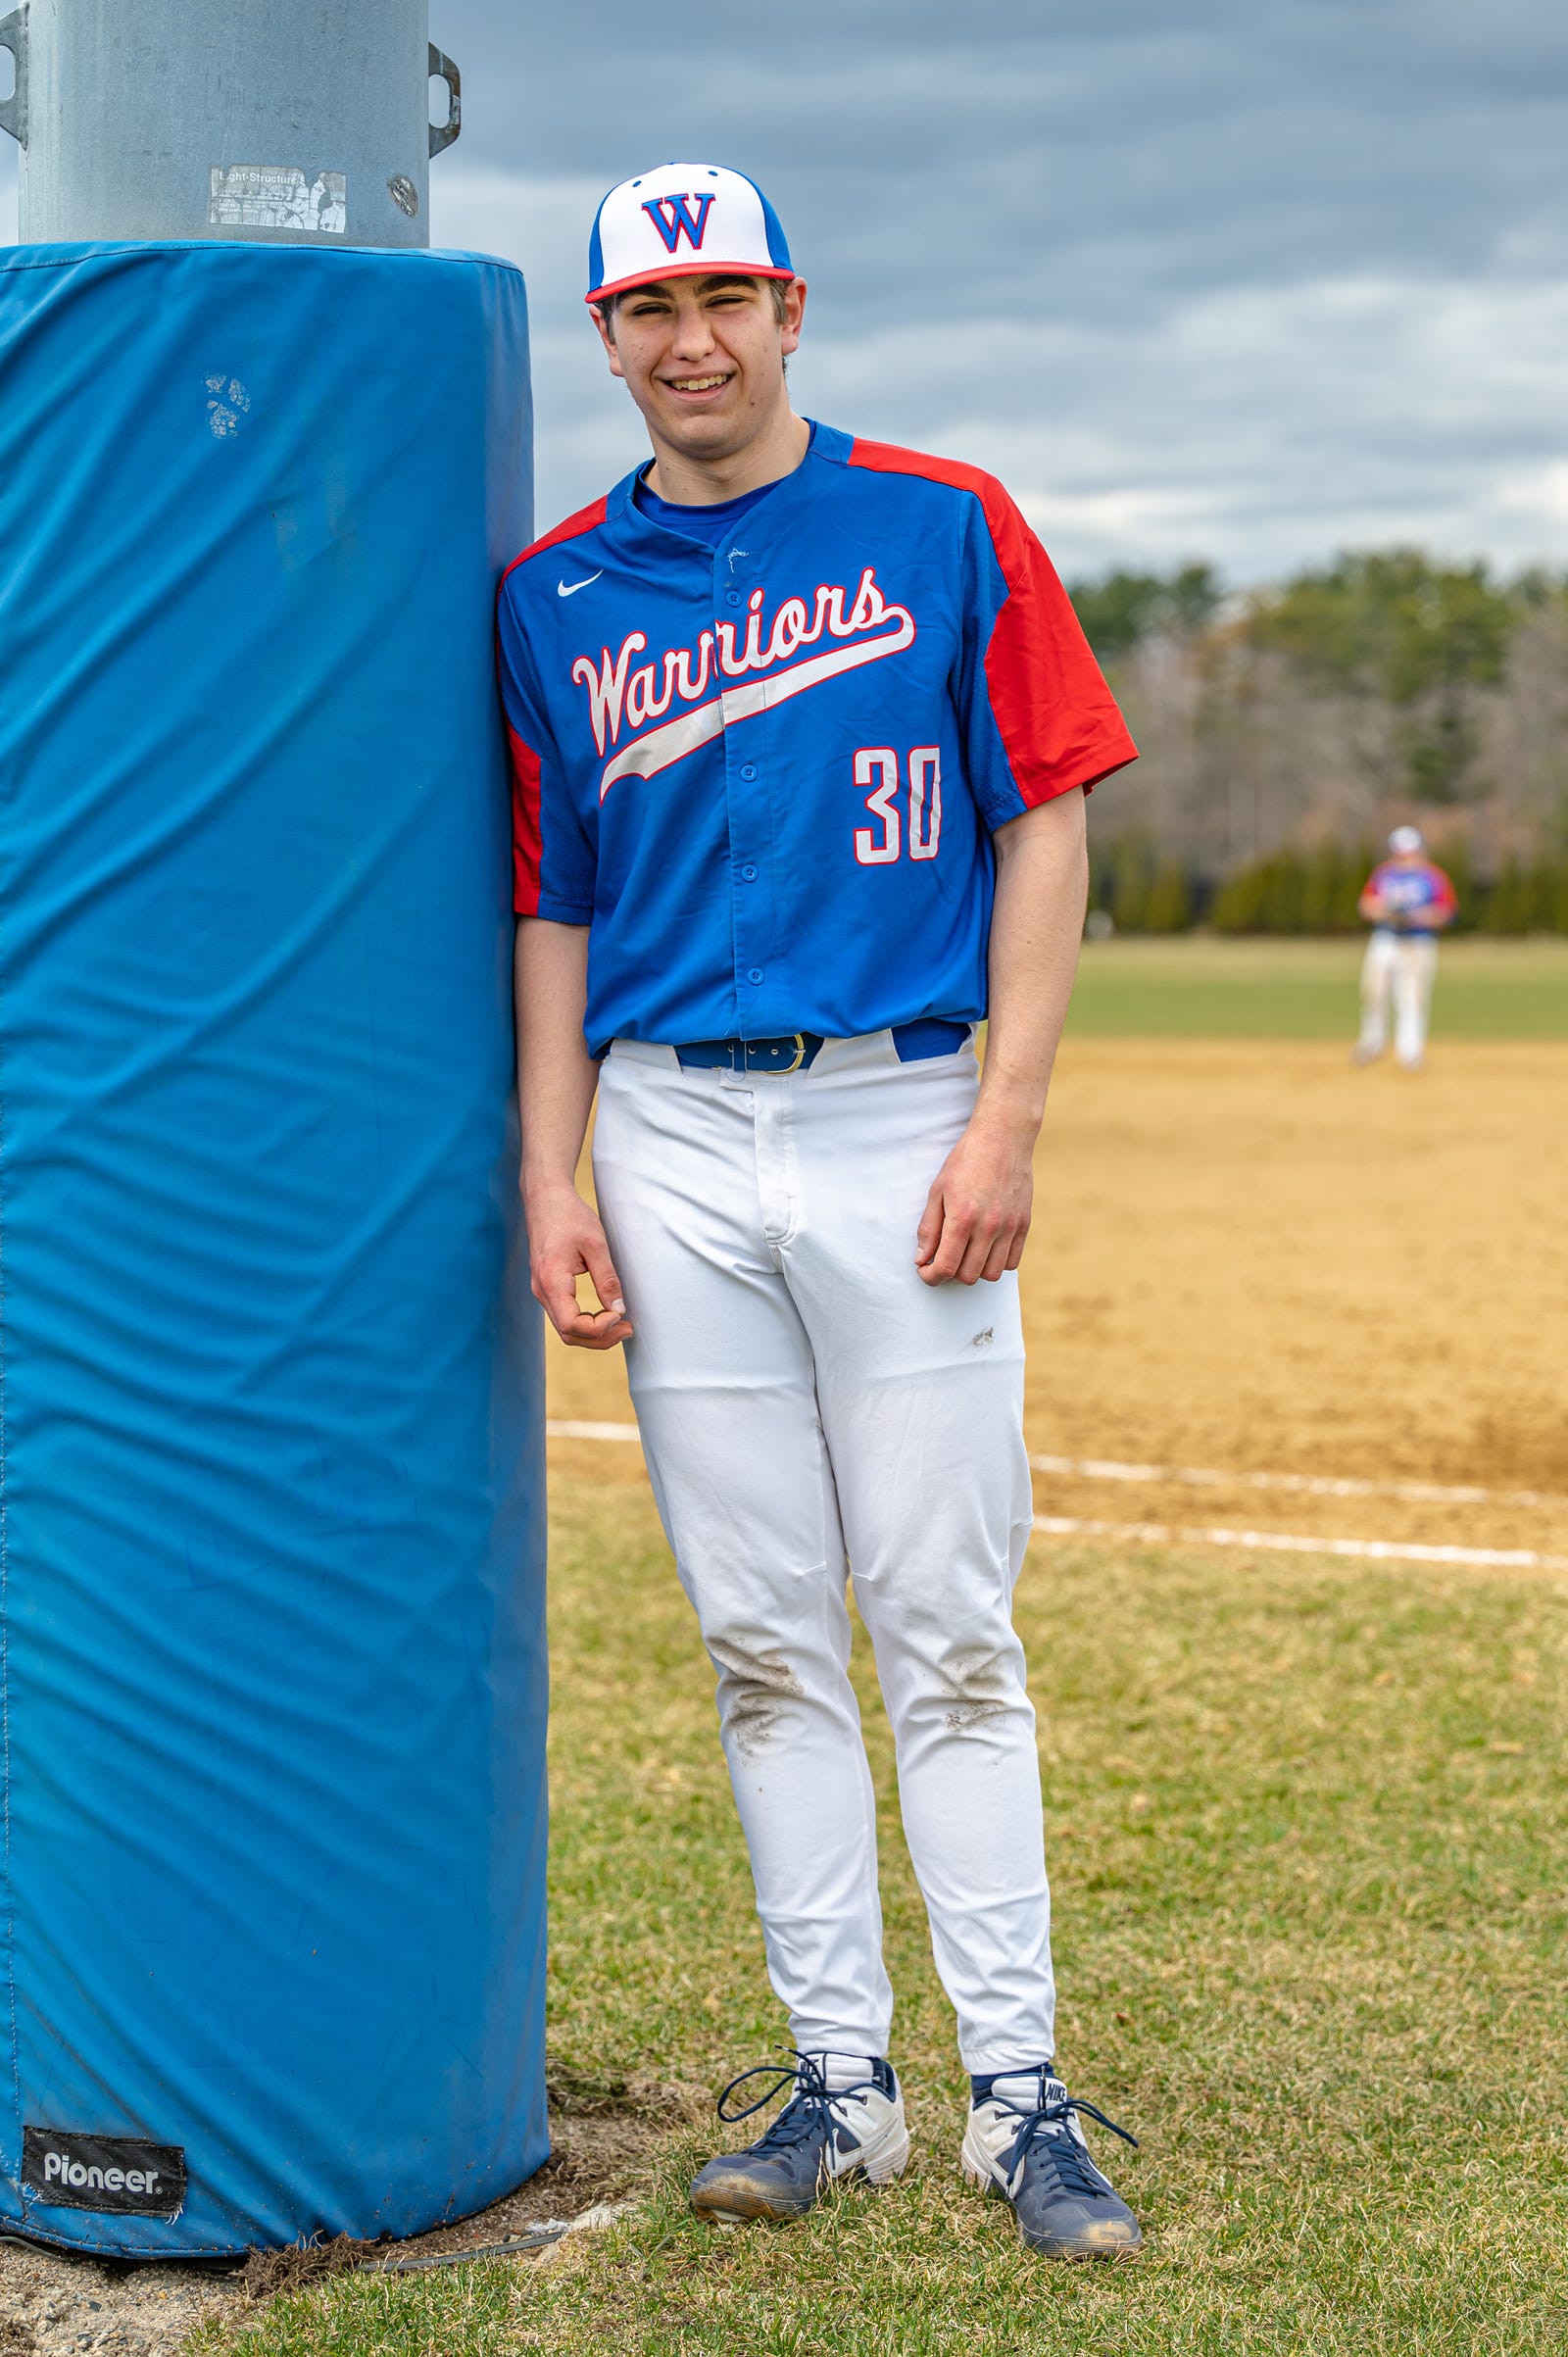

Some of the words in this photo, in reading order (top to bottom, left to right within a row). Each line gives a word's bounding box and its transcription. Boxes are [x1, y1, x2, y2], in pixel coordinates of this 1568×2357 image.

[219, 171, 297, 185] Lght-Structure
[641, 193, 715, 254] W
[572, 566, 894, 759] Warriors
[853, 745, 942, 865] 30
[1046, 2083, 1066, 2103] NIKE
